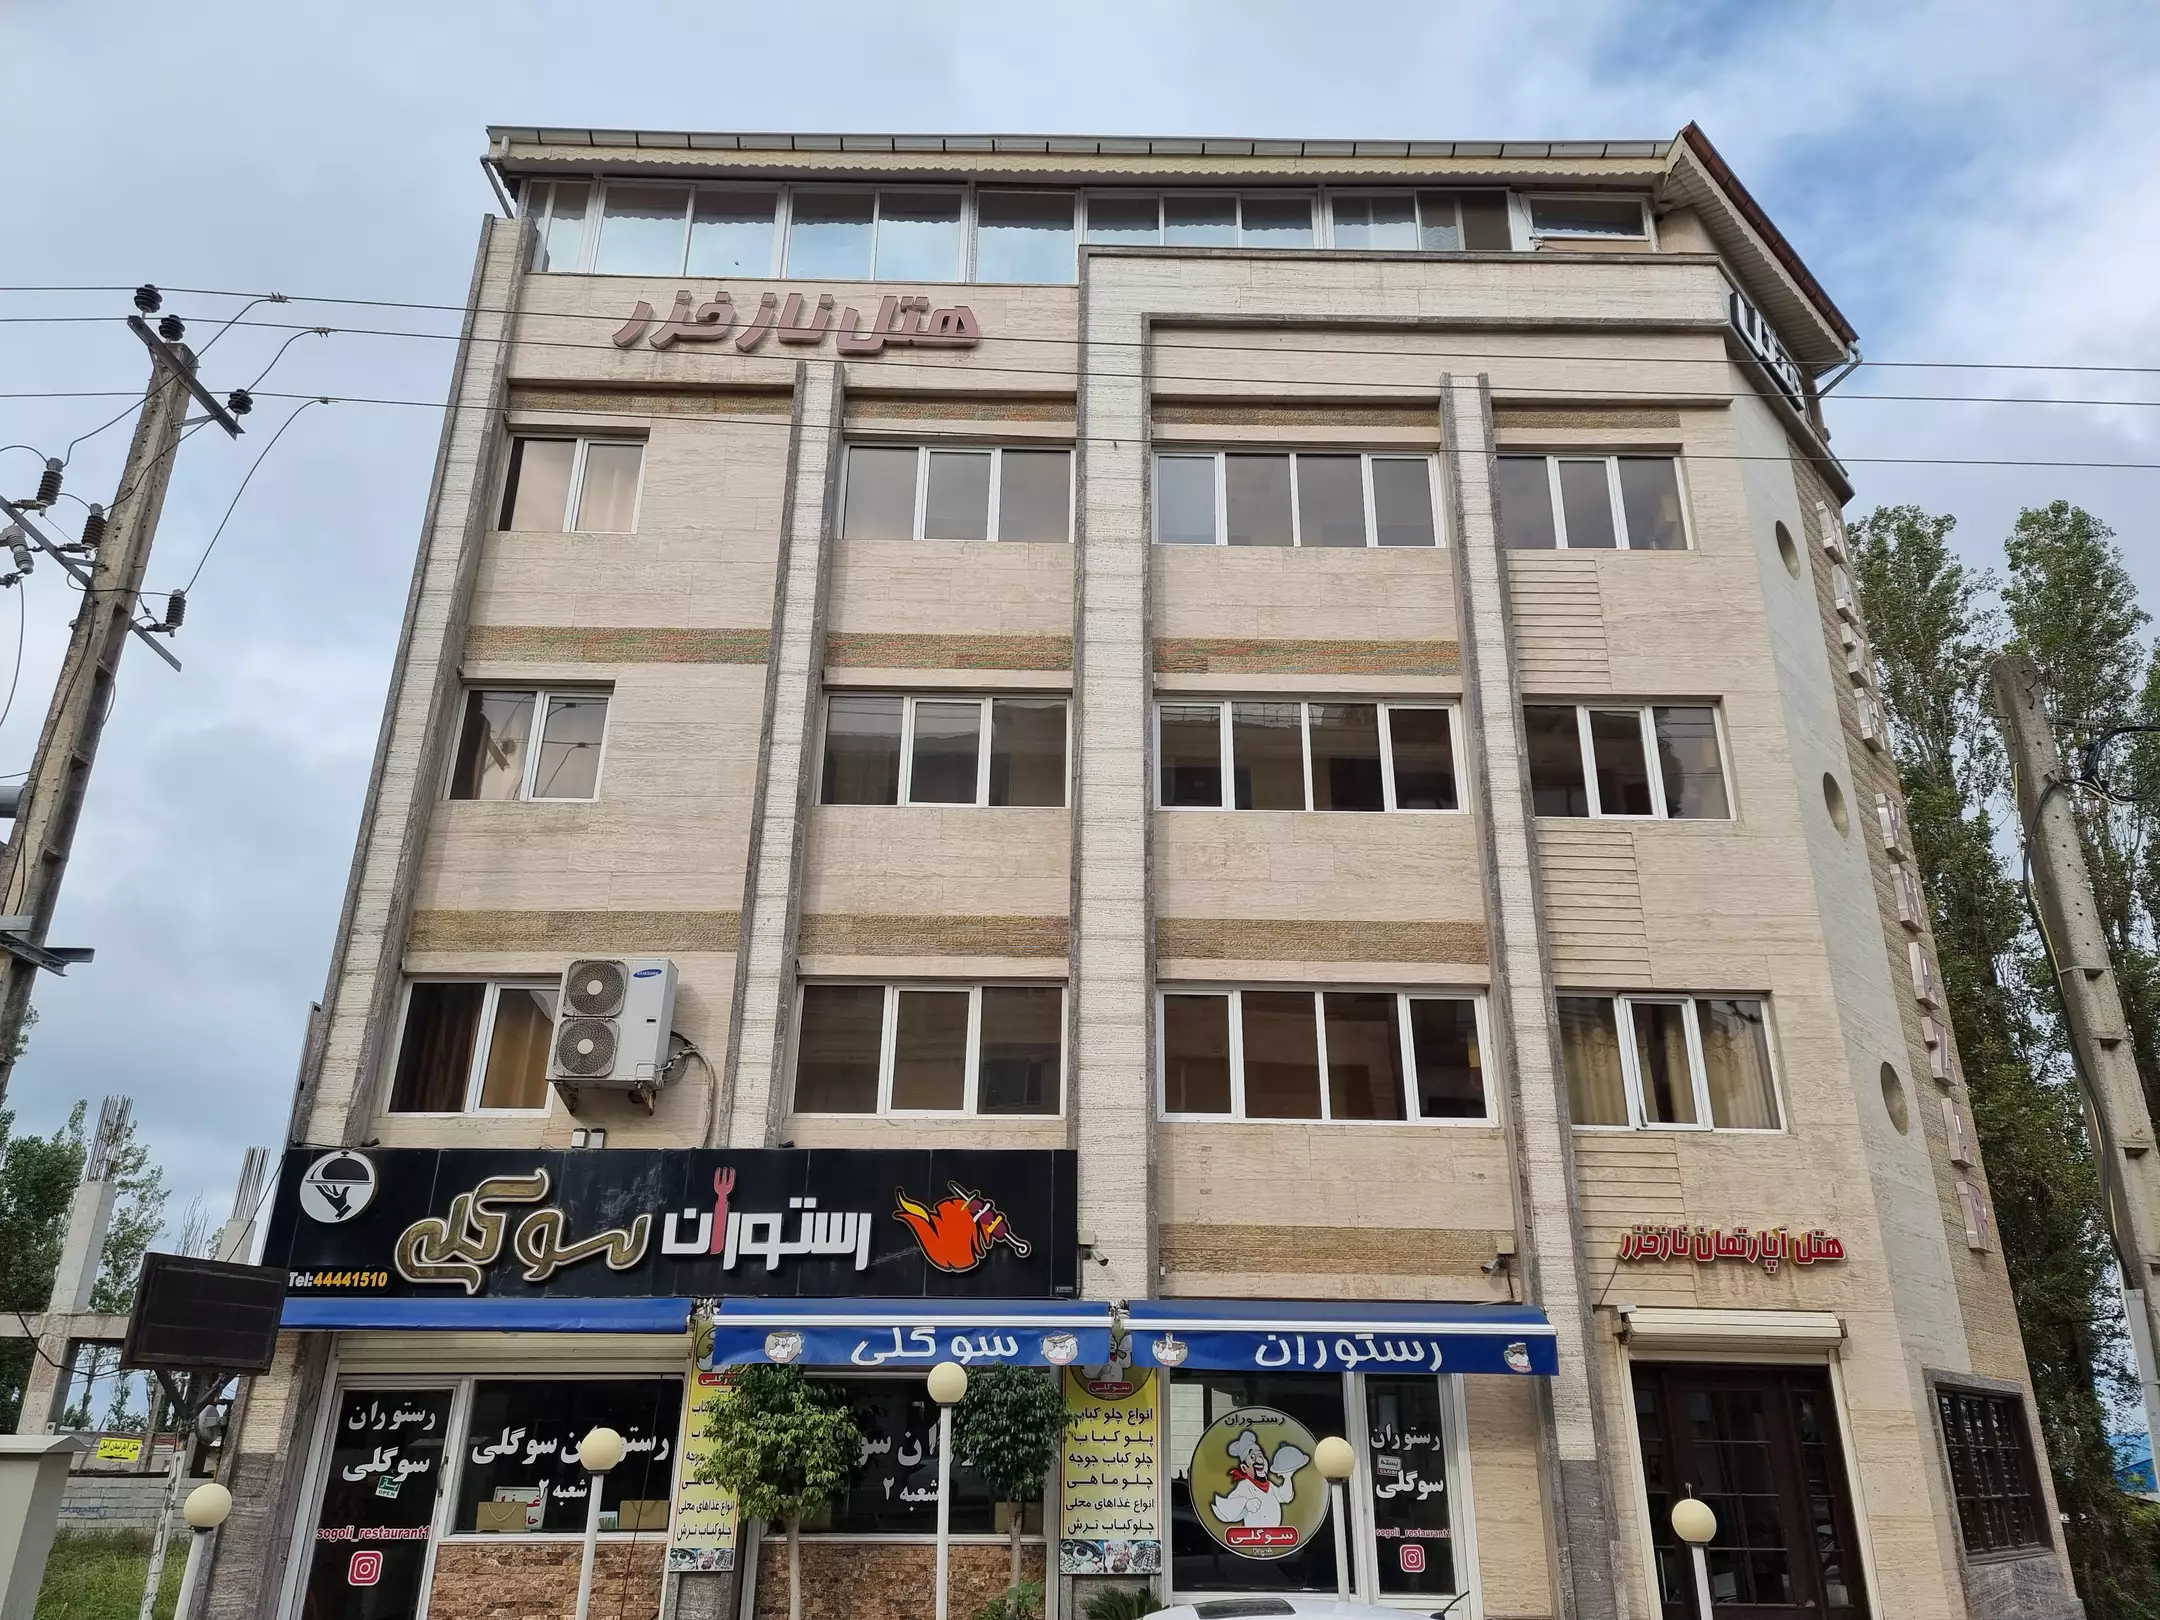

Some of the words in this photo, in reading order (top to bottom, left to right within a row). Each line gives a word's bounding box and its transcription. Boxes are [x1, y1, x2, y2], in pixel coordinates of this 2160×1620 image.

[836, 295, 981, 356] هتل
[661, 1166, 872, 1272] رستوران
[1692, 1224, 1790, 1274] آپارتمان
[1793, 1228, 1847, 1265] هتل
[1254, 1333, 1444, 1372] رستوران
[348, 1401, 436, 1431] رستوران
[1127, 1407, 1153, 1426] انواع
[1224, 1414, 1286, 1427] رستوران
[1371, 1422, 1441, 1451] رستوران
[341, 1445, 431, 1482] سوگلی
[1068, 1453, 1099, 1469] جوجه
[1102, 1452, 1132, 1469] کباب
[538, 1478, 550, 1499] ۲
[552, 1479, 588, 1506] شعبه
[882, 1476, 895, 1500] ۲
[1376, 1469, 1444, 1500] سوگلی
[678, 1500, 695, 1514] محلی
[720, 1500, 735, 1516] انواع
[1065, 1496, 1092, 1511] محلی
[1094, 1496, 1131, 1511] غذاهای
[1132, 1497, 1155, 1514] انواع
[316, 1525, 431, 1542] sogoli_restaurant1
[1067, 1517, 1099, 1536] ترش
[1230, 1529, 1294, 1544] سوگلی
